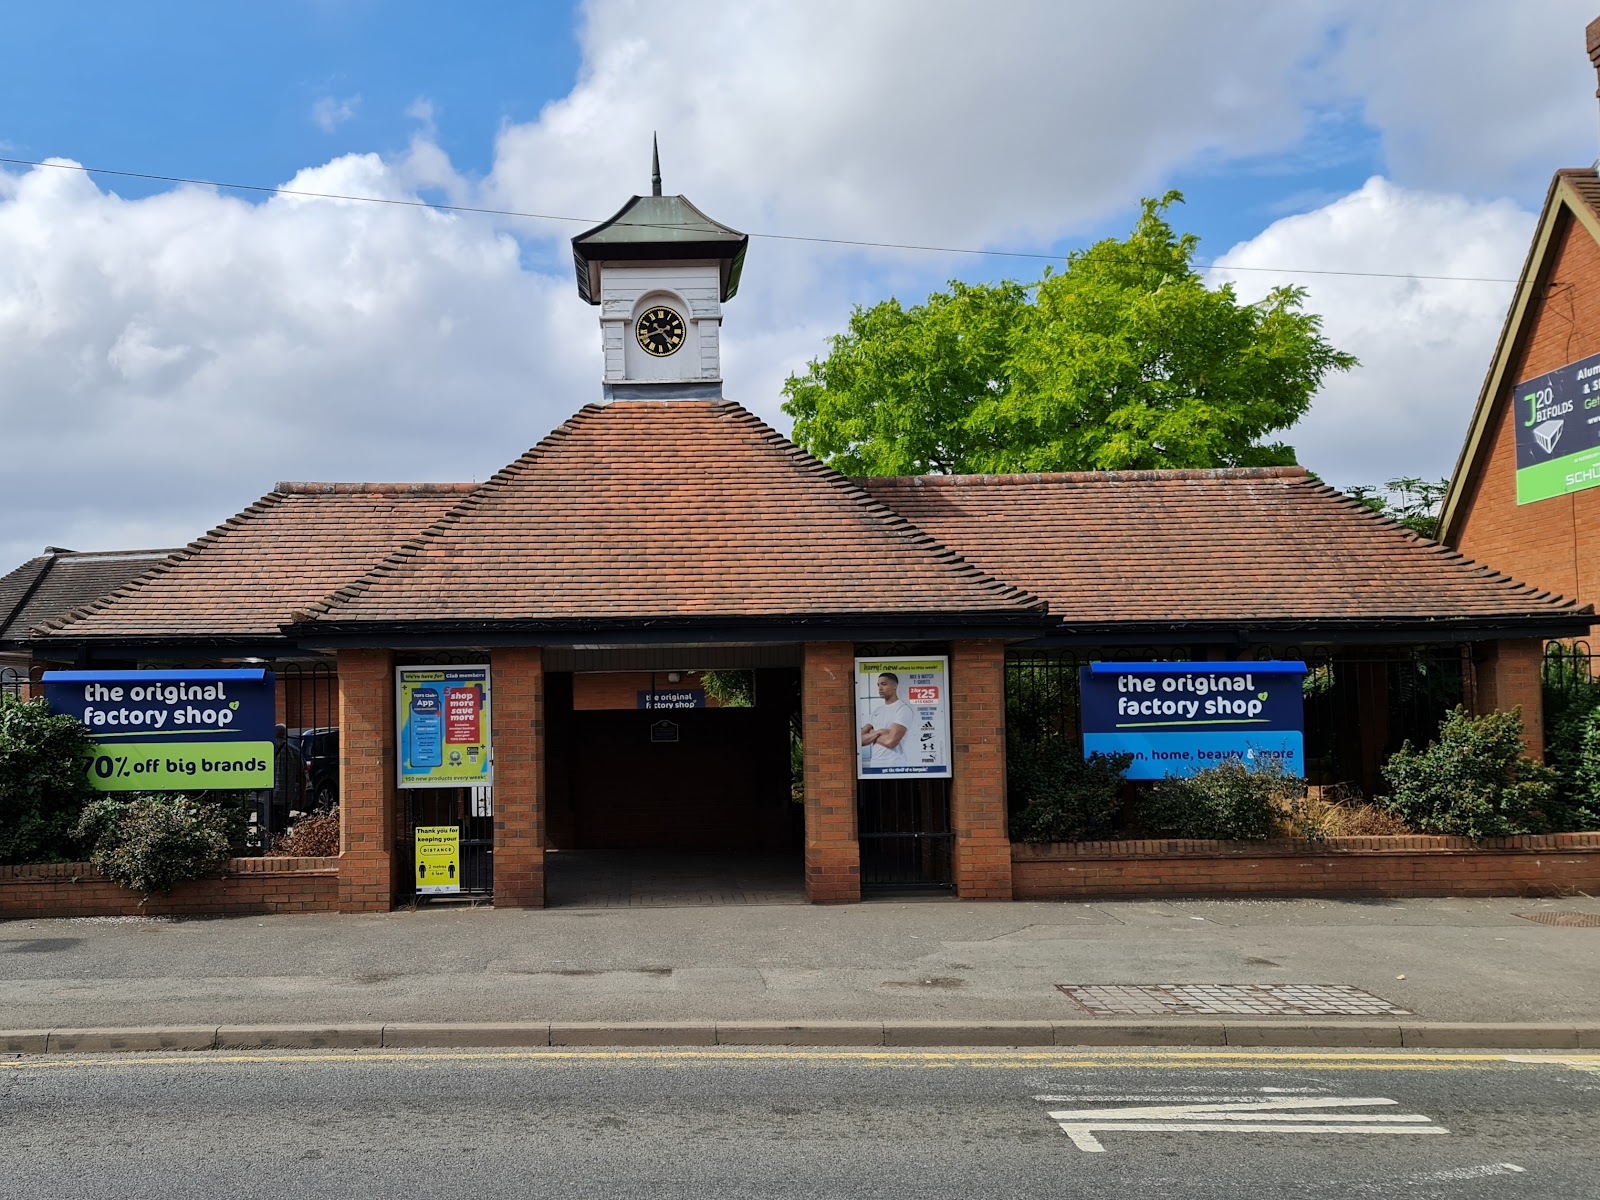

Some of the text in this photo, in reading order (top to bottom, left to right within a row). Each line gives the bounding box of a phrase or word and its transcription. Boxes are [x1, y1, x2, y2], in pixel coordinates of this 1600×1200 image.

[1583, 378, 1600, 394] & S
[1537, 400, 1573, 422] BIFOLDS
[84, 682, 226, 704] the original
[918, 689, 935, 698] £25
[1118, 674, 1255, 695] the original
[417, 700, 434, 708] App
[451, 692, 473, 700] shop
[661, 693, 692, 701] original
[1118, 696, 1262, 718] factory shop
[84, 706, 233, 728] factory shop
[1152, 750, 1194, 761] home,
[1197, 749, 1243, 760] beauty
[1247, 749, 1254, 759] &
[80, 756, 266, 778] 70% off big brands
